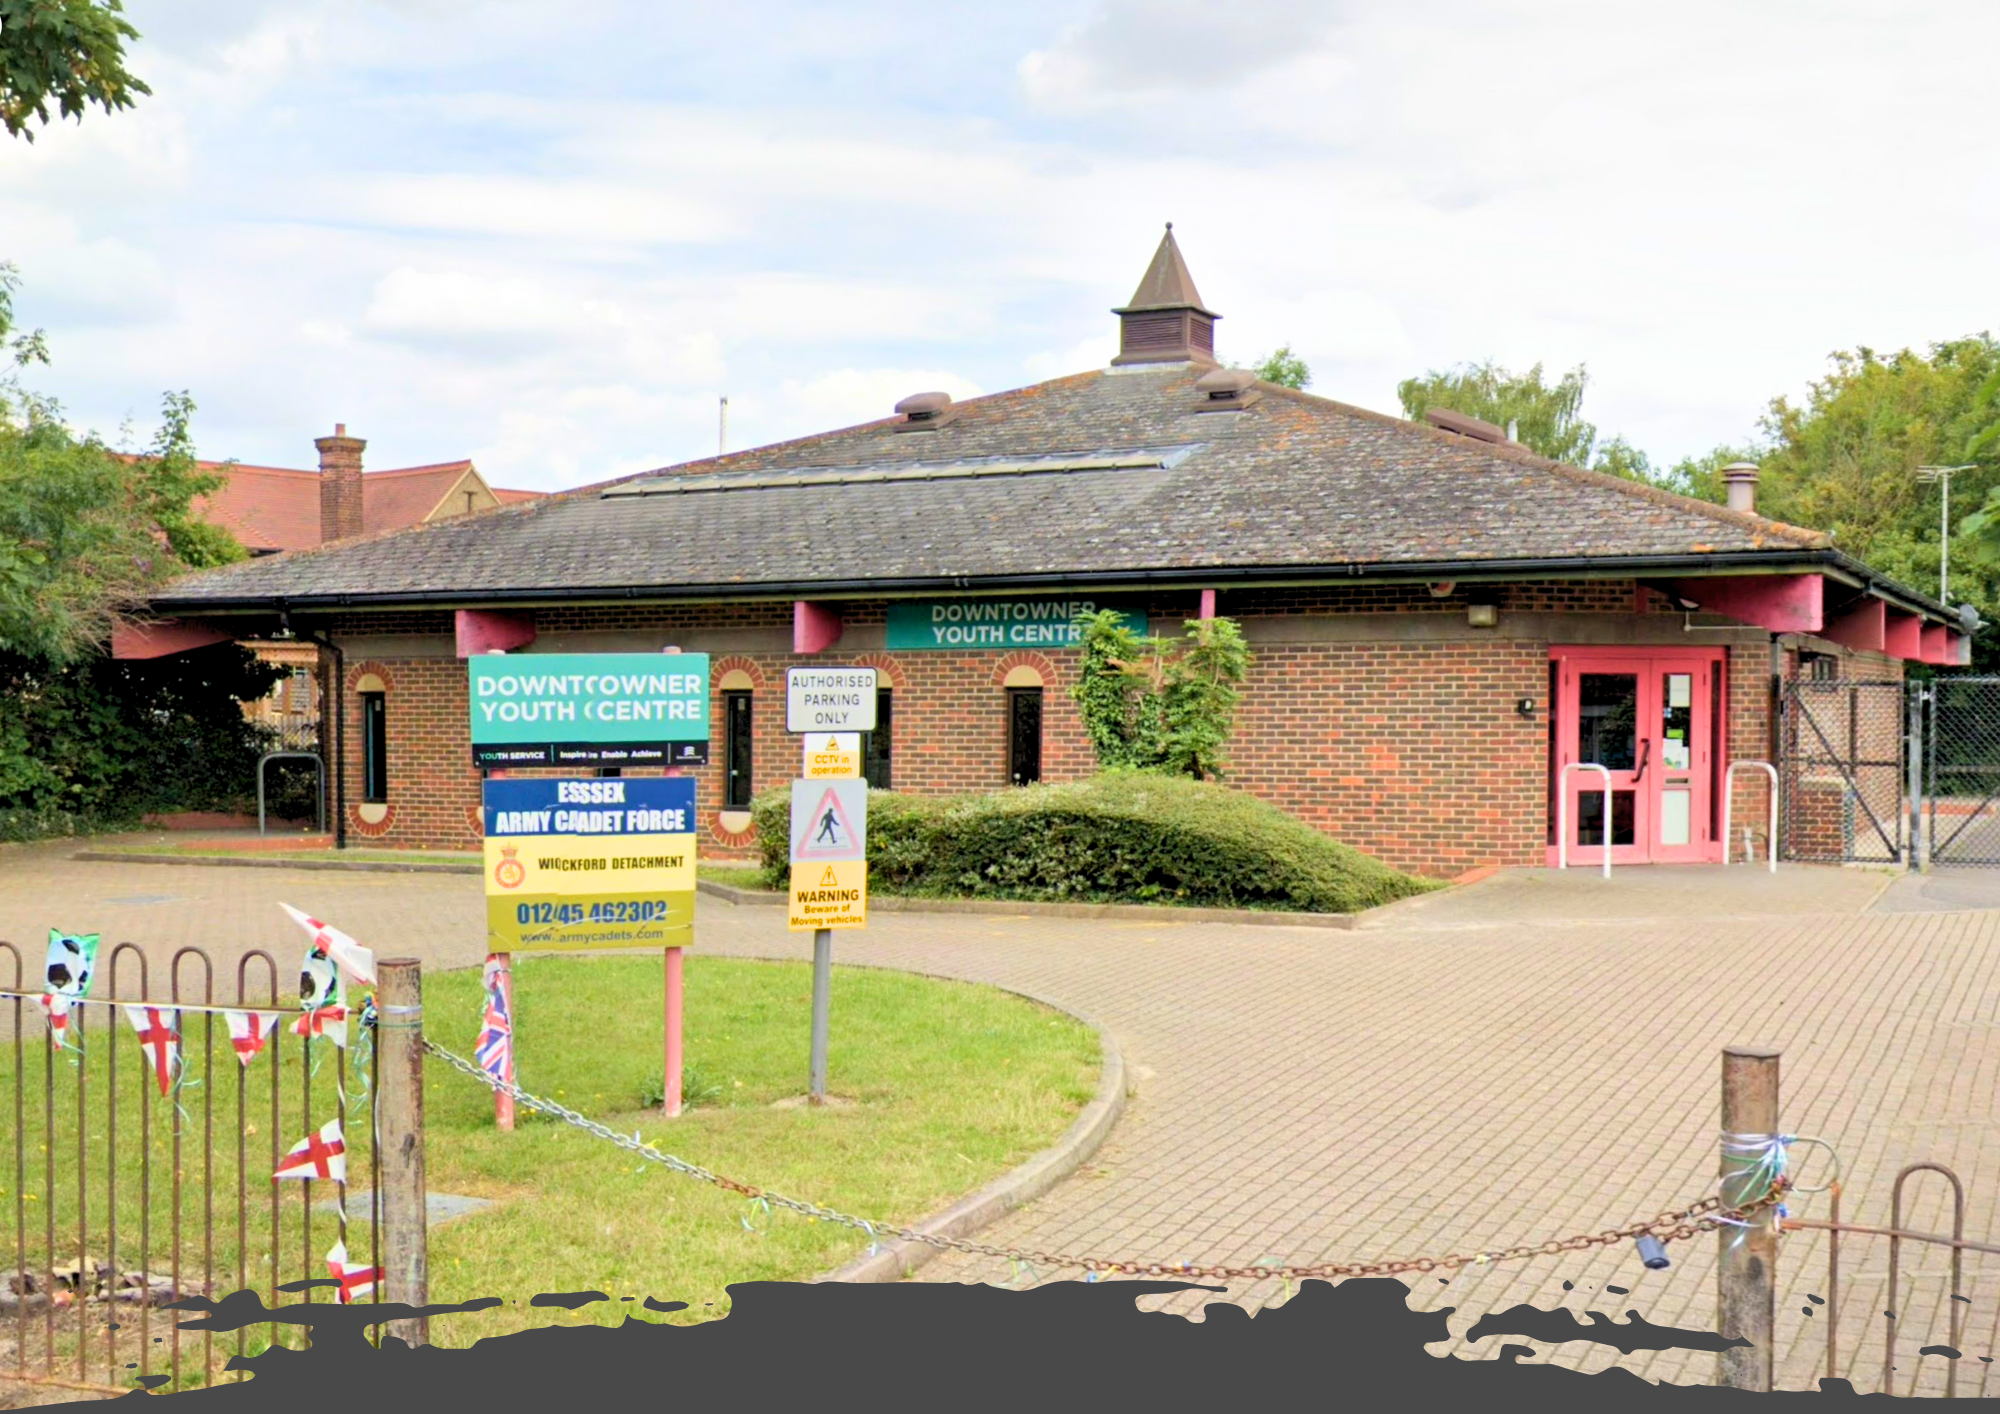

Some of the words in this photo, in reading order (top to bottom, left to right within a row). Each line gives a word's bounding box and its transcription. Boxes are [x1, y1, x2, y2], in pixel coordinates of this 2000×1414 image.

[932, 625, 1004, 644] YOUTH
[1010, 622, 1093, 643] CENTR
[791, 675, 873, 689] AUTHORISED
[804, 693, 860, 707] PARKING
[479, 701, 576, 722] YOUTH
[814, 711, 849, 725] ONLY
[479, 751, 509, 761] YOUTH
[509, 750, 546, 760] SERVICE
[600, 750, 629, 759] Enable
[630, 749, 663, 758] Achieve
[814, 754, 840, 765] CCTV
[841, 754, 850, 765] in
[811, 765, 852, 776] operation
[495, 811, 552, 833] ARMY
[626, 809, 686, 832] FORCE
[611, 855, 685, 870] DETACHMENT
[796, 889, 860, 903] WARNING
[588, 899, 668, 923] 462302
[804, 904, 839, 914] Beware
[840, 903, 851, 913] of
[790, 916, 824, 928] Moving
[825, 914, 863, 925] vehicles
